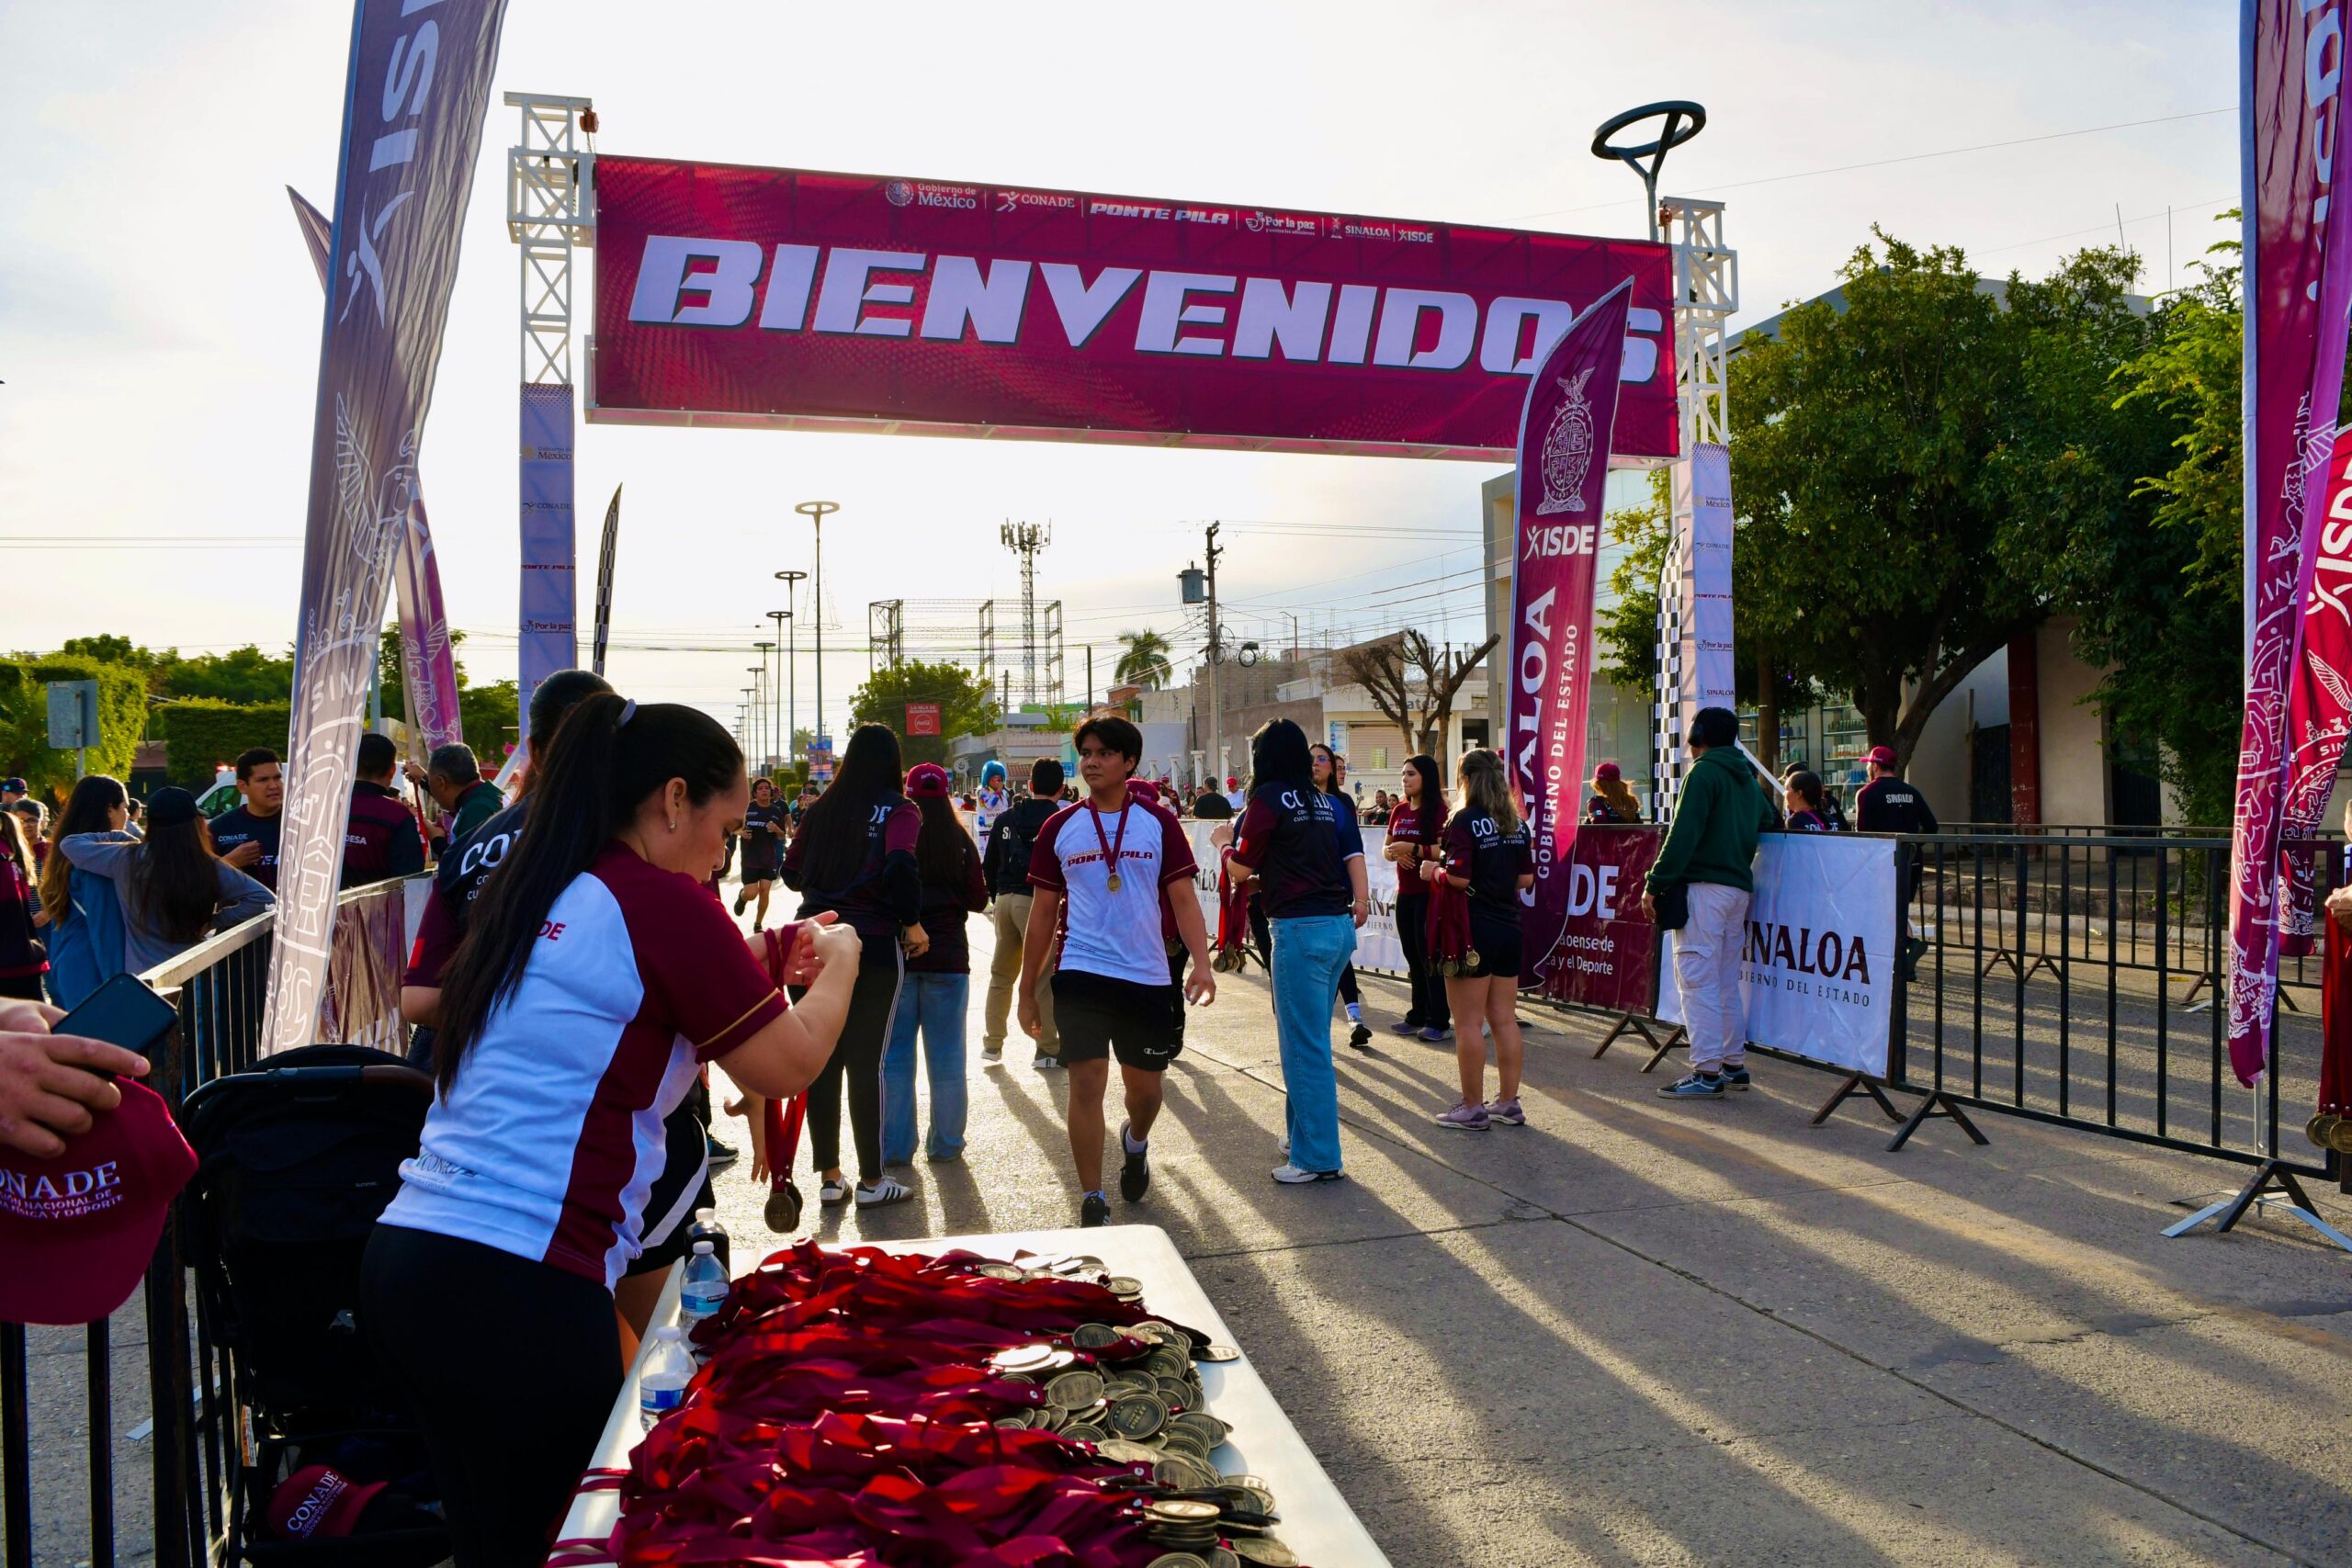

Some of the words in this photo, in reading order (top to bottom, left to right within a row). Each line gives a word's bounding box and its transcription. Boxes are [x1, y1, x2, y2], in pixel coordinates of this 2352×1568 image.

[368, 0, 444, 173] IS
[918, 184, 964, 195] Gobierno
[967, 186, 976, 195] de
[918, 191, 976, 209] México
[1022, 194, 1074, 209] CONADE
[1090, 202, 1170, 220] PONTE
[1175, 209, 1229, 224] PILA
[1265, 216, 1283, 227] Por
[1286, 217, 1295, 228] la
[1297, 220, 1316, 231] paz
[1345, 225, 1390, 237] SINALOA
[538, 451, 572, 460] México
[1705, 501, 1730, 509] México
[1557, 624, 1578, 706] ESTADO
[1550, 716, 1568, 758] DEL
[1537, 765, 1561, 879] GOBIERNO
[218, 833, 249, 842] CONADE
[1120, 851, 1153, 860] PILA
[1601, 935, 1614, 953] de
[1558, 956, 1565, 970] y
[1566, 955, 1575, 969] el
[1577, 956, 1613, 976] Deporte
[1786, 979, 1809, 995] DEL
[1818, 985, 1870, 1008] ESTADO
[0, 1161, 120, 1200] NADE
[96, 1189, 112, 1201] DE
[52, 1210, 60, 1220] Y
[64, 1194, 123, 1217] DEPORTE
[287, 1471, 339, 1532] CONADE
